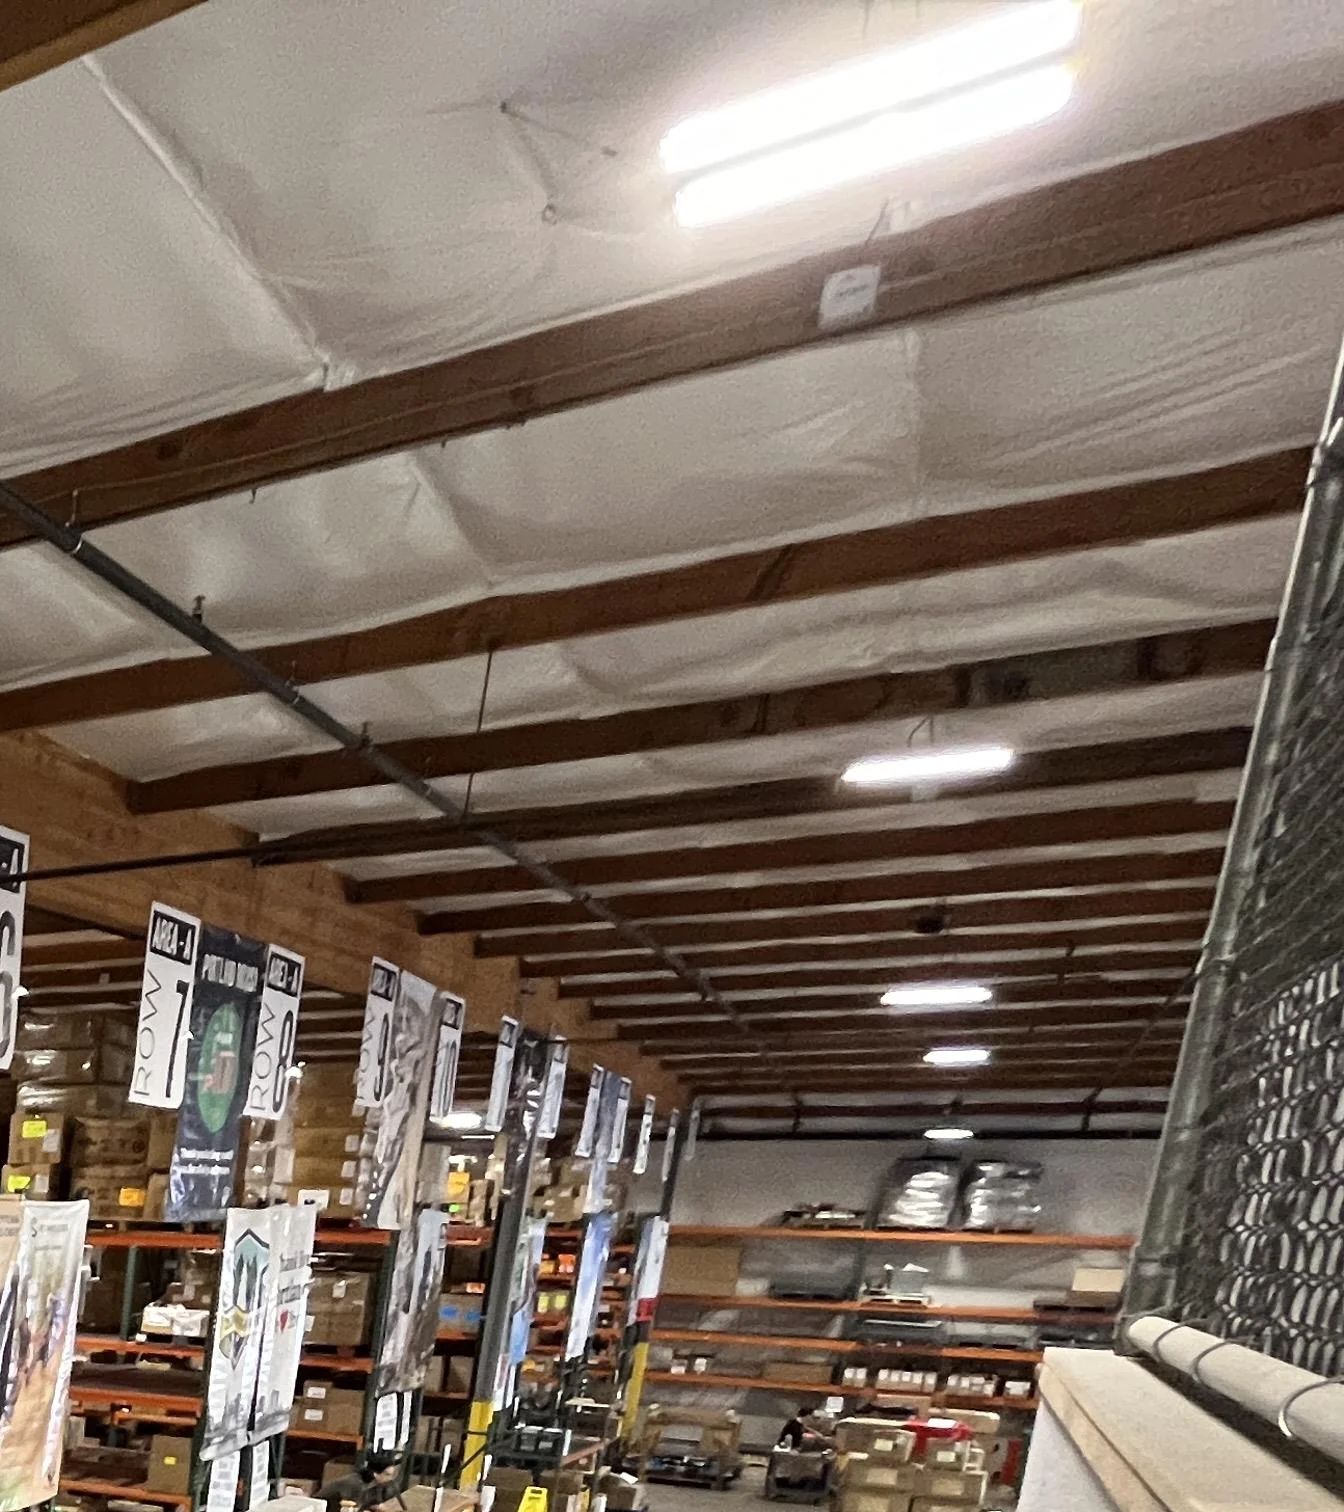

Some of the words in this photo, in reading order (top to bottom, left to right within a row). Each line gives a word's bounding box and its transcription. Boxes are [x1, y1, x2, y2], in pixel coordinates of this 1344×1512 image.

[134, 969, 162, 1097] ROW
[165, 980, 189, 1098] 7
[251, 1002, 276, 1110] ROW
[273, 1010, 294, 1113] 8
[374, 1013, 389, 1101] 9
